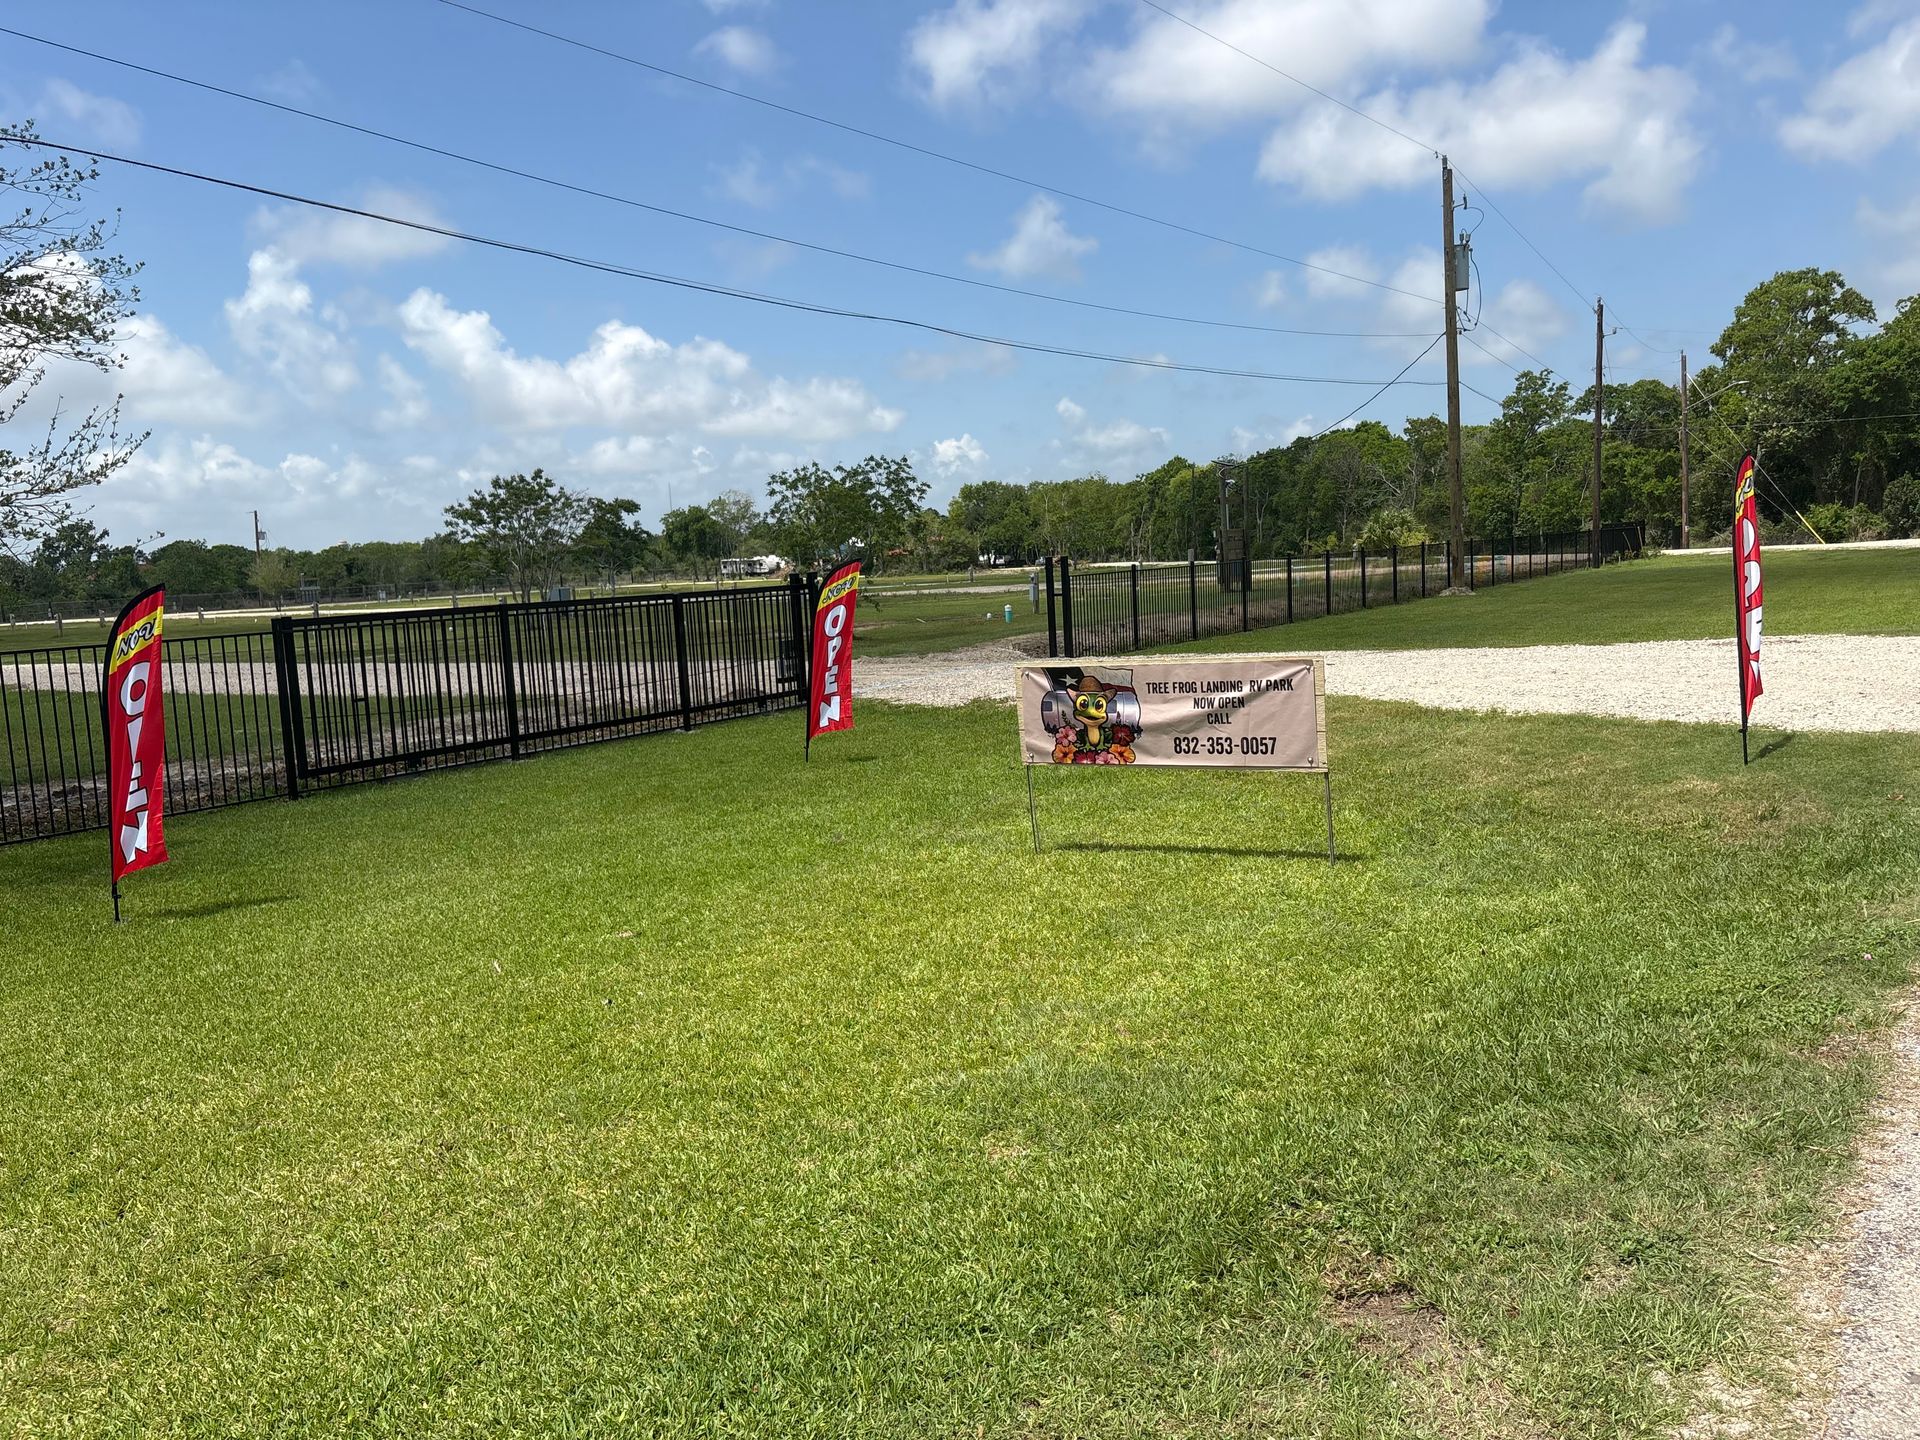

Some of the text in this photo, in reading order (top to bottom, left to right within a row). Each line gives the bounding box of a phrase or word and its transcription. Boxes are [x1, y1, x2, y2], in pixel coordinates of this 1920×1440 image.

[1742, 517, 1763, 682] PE
[819, 604, 847, 728] OPEN
[1146, 679, 1294, 693] TREE FROG LANDING RV PARK
[1193, 696, 1245, 709] NOW OPEN
[1207, 713, 1232, 724] CALL
[1173, 736, 1277, 755] 832-353-0057
